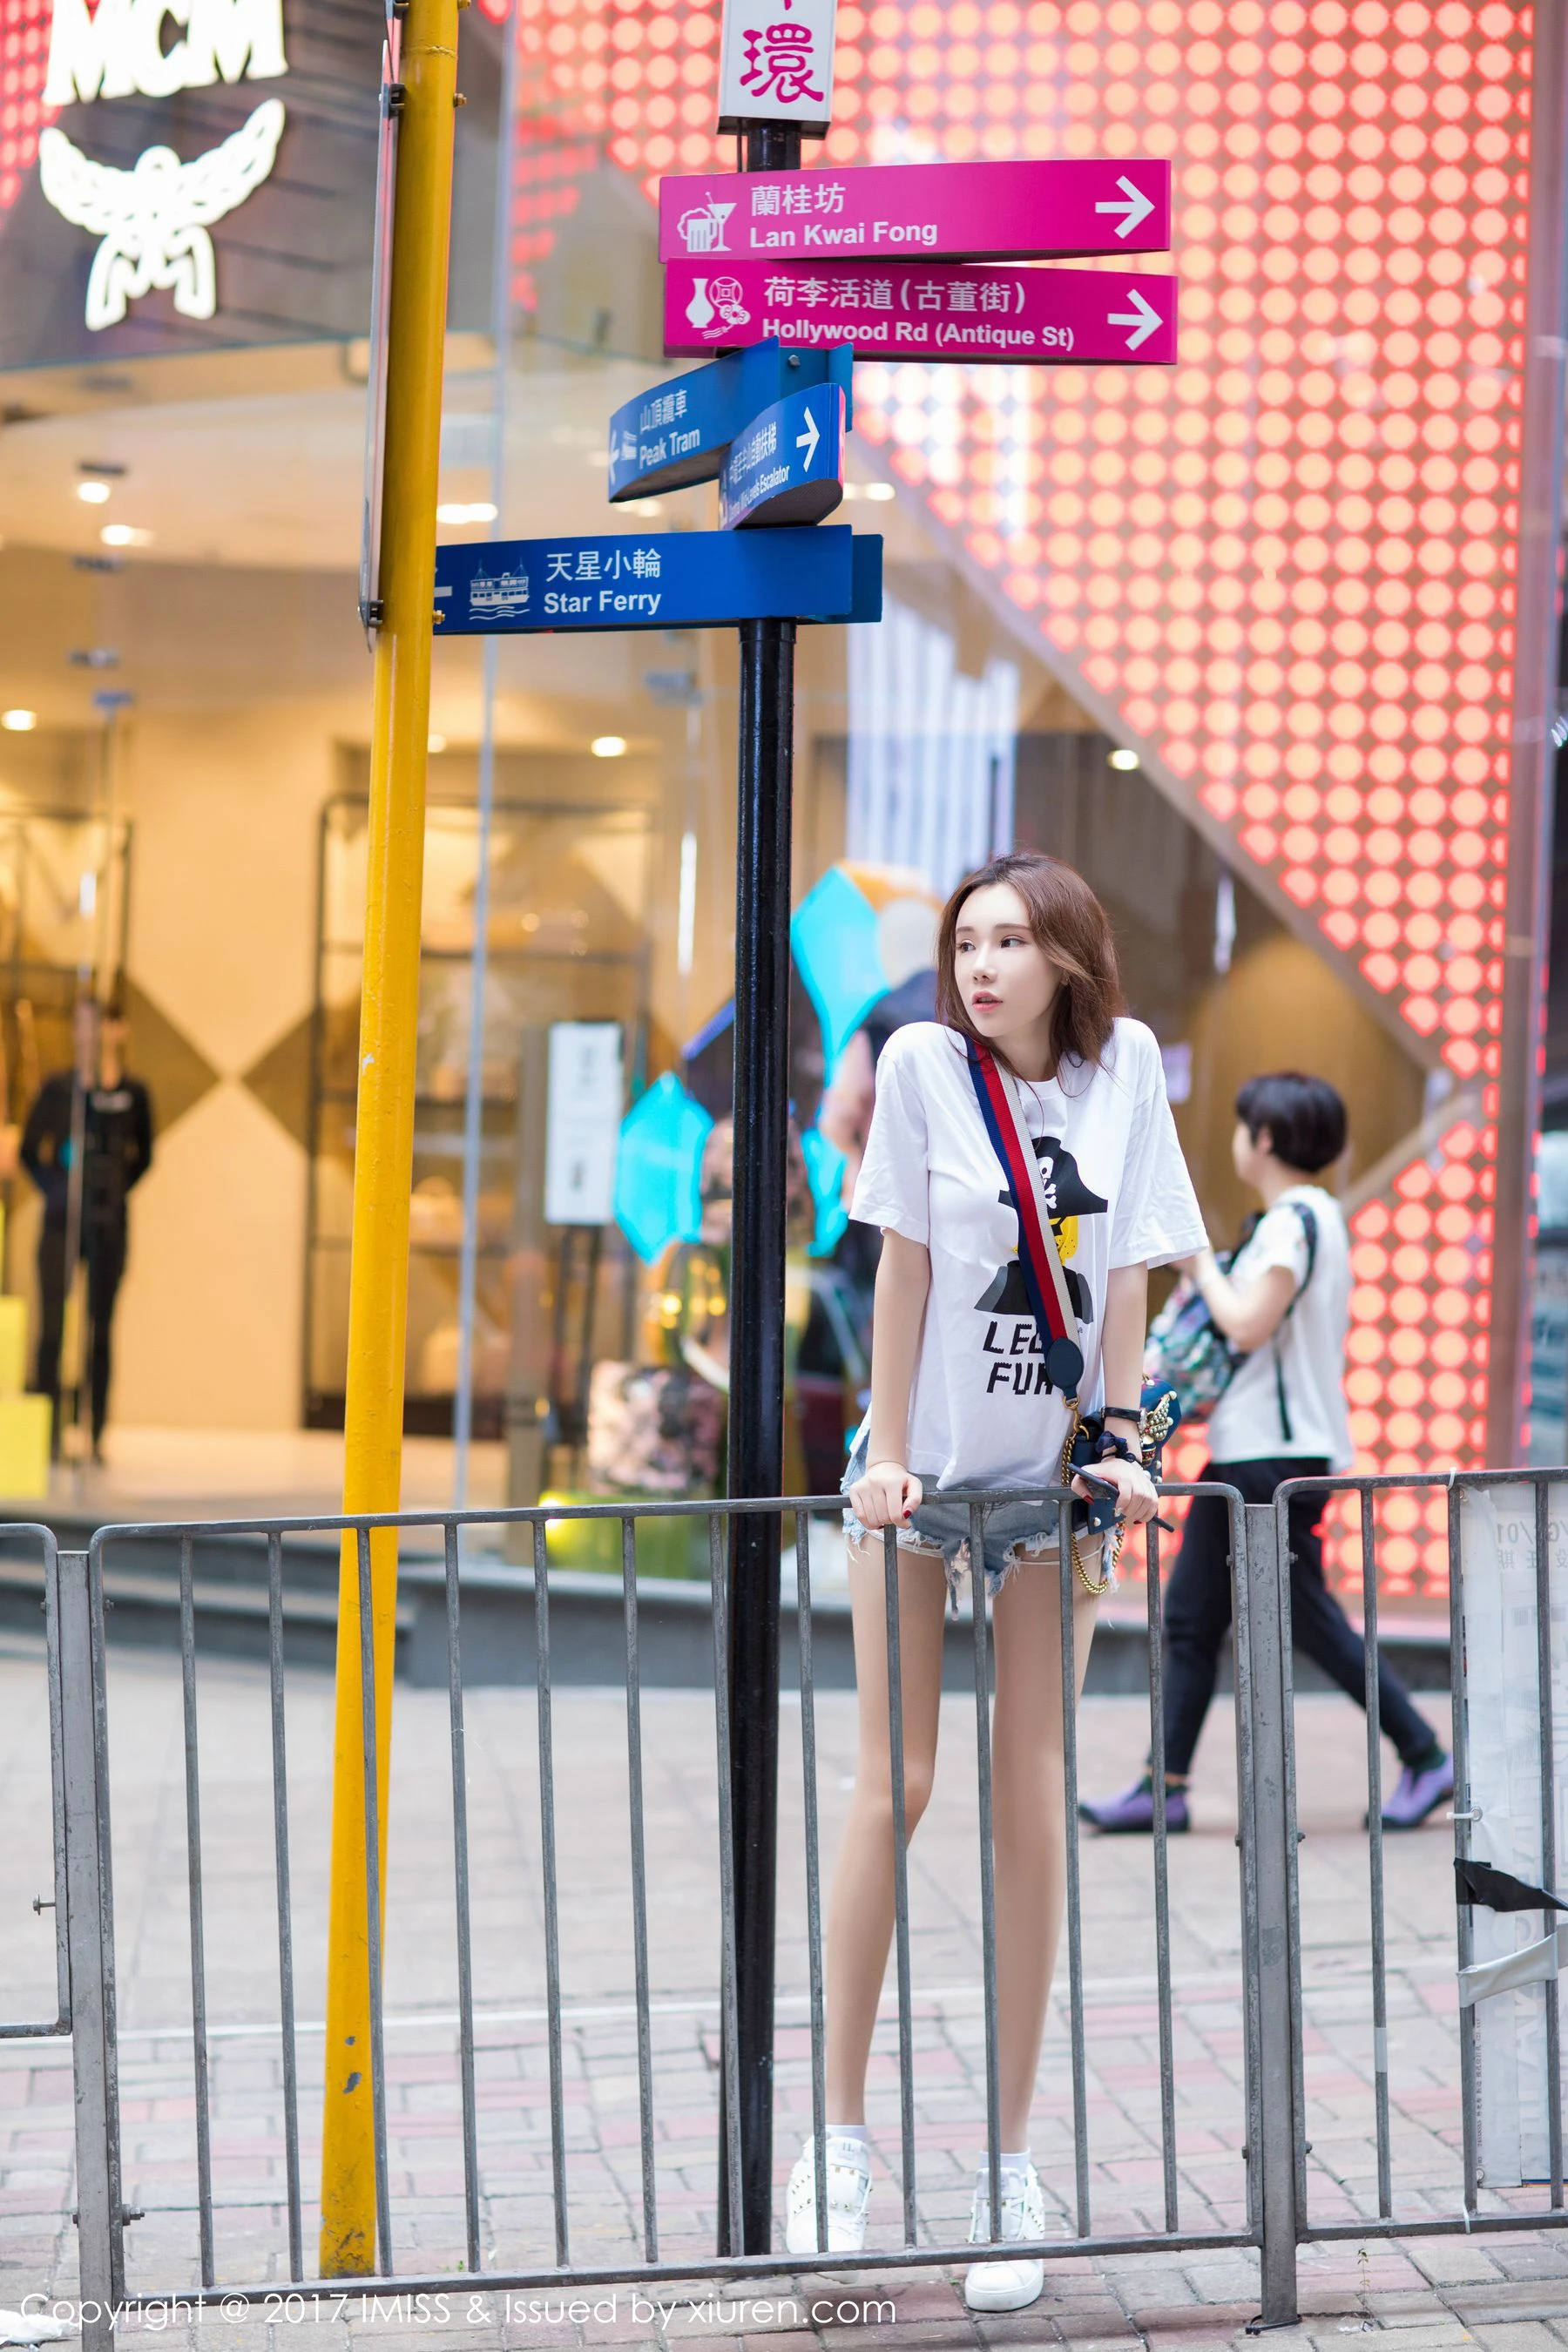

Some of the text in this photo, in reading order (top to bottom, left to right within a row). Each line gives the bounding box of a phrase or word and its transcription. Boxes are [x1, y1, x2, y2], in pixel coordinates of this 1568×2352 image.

[41, 0, 289, 106] MCM
[740, 0, 824, 104] 環
[751, 182, 846, 217] 蘭桂坊
[750, 221, 938, 248] Lan Kwai Fong
[762, 319, 1074, 351] Hollywood Rd (Antique St)
[639, 429, 700, 470] Peak Tram
[760, 464, 790, 495] Escalator
[545, 548, 662, 582] 天星小輪
[544, 590, 661, 615] Star Ferry
